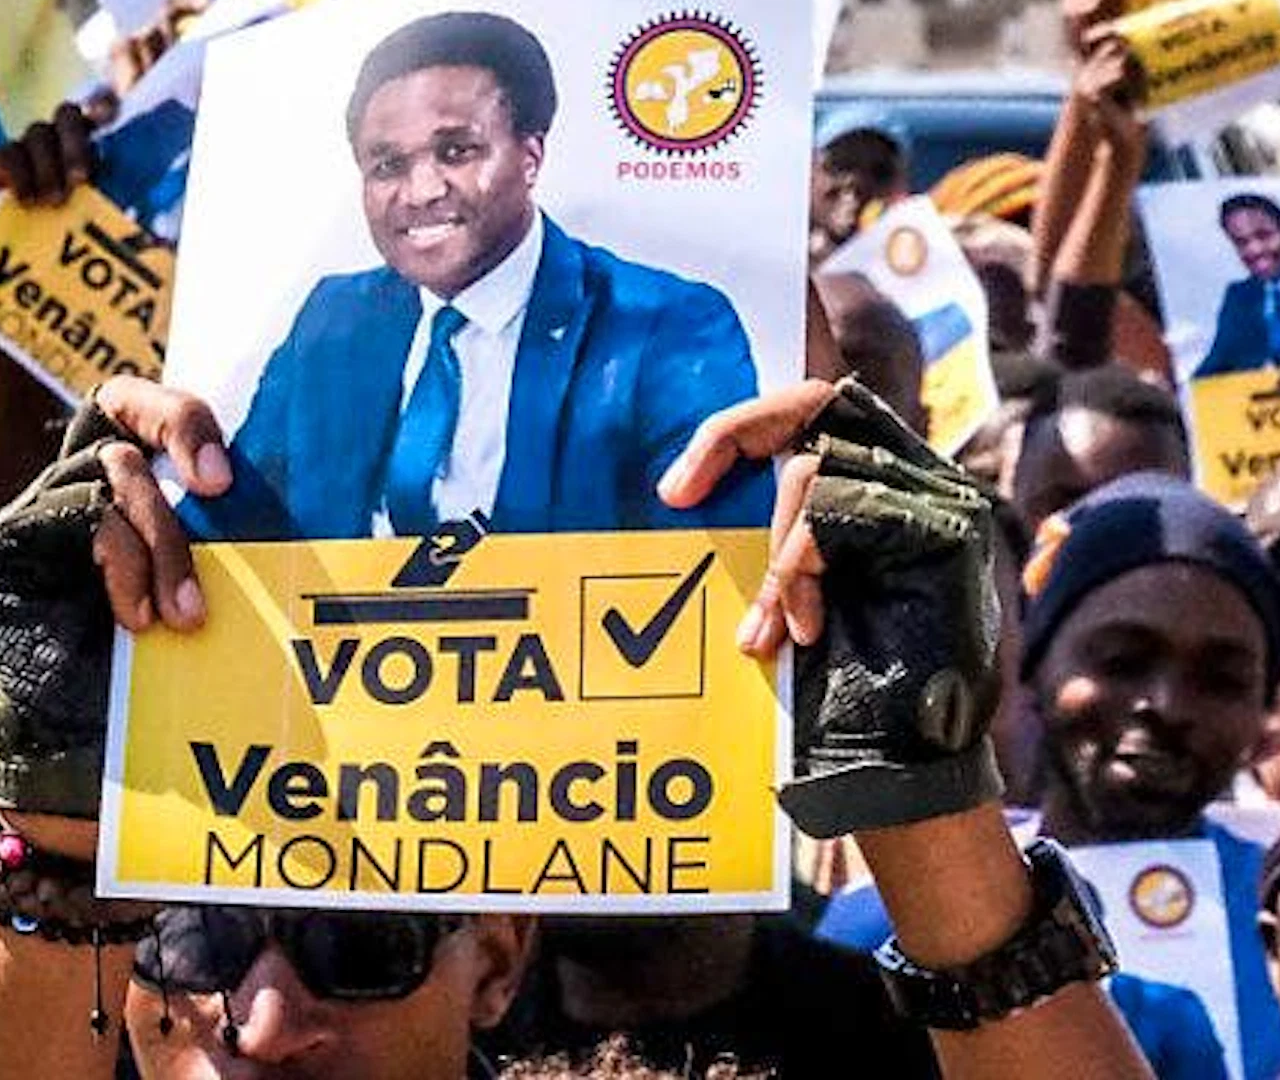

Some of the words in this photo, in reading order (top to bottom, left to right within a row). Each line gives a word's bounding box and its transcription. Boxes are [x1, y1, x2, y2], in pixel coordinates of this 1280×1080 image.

[617, 161, 741, 180] PODEMOS
[59, 231, 156, 332] VOTA
[291, 633, 564, 705] VOTA
[189, 739, 715, 823] Venâncio
[204, 831, 711, 895] MONDLANE
